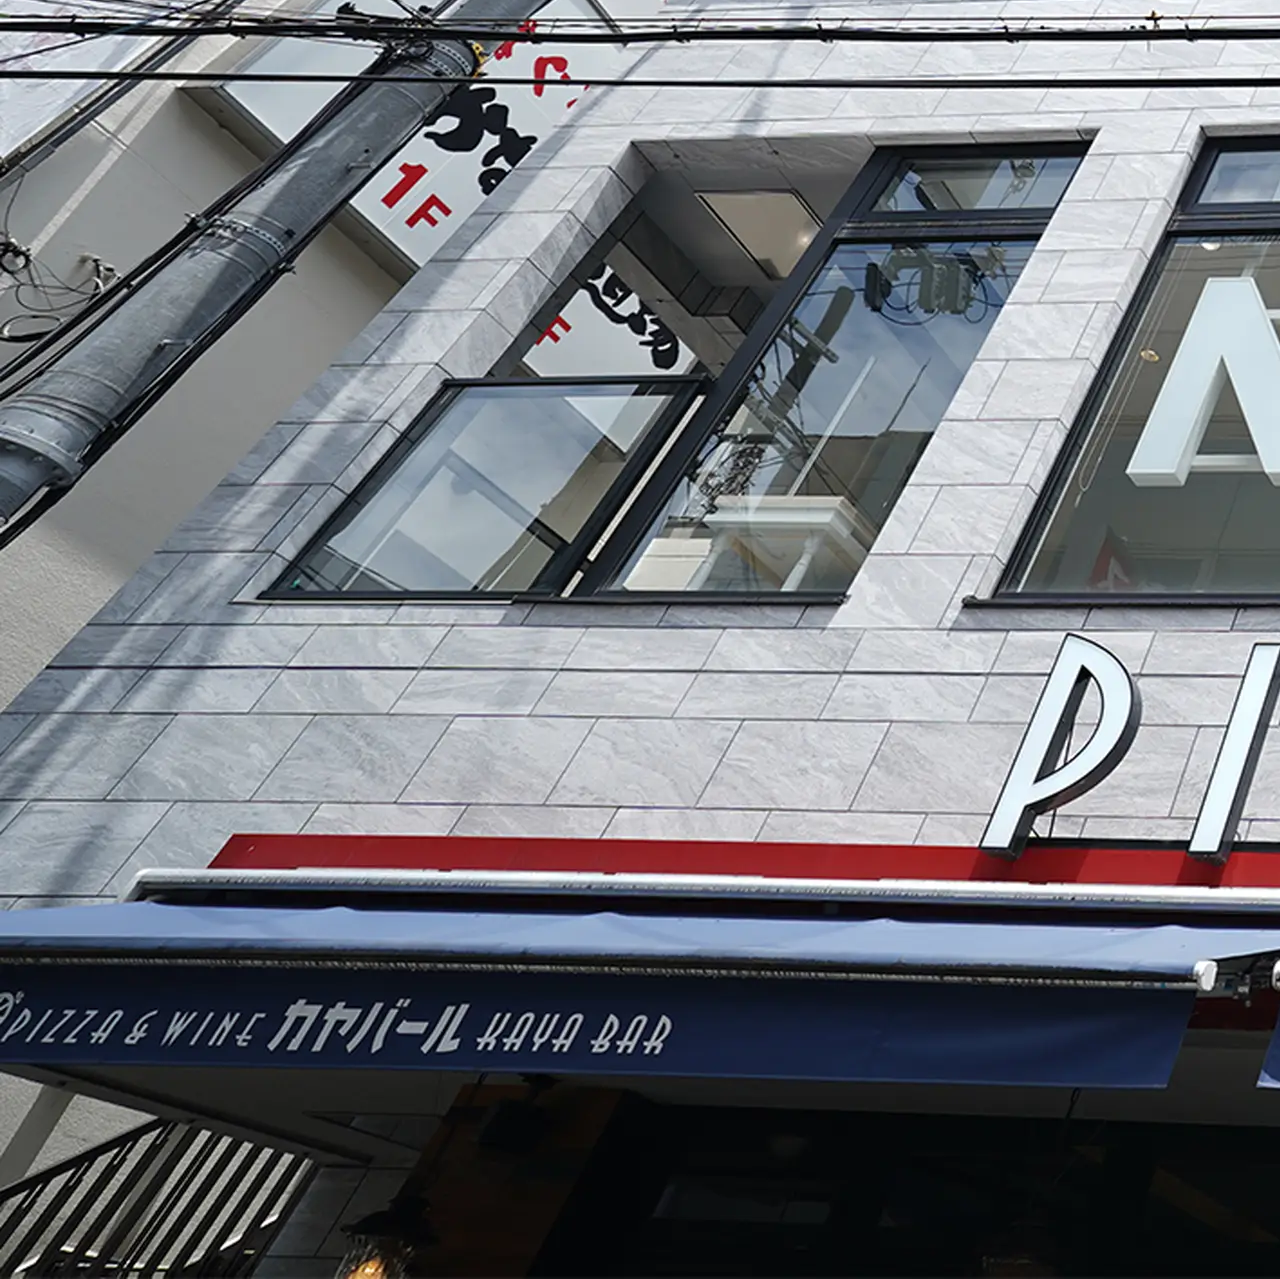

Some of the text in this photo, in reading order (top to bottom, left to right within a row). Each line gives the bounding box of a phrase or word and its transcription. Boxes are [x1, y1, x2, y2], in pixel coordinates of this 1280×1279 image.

[381, 153, 452, 228] 1F
[1, 998, 672, 1055] PIZZA & WINE カヤバール KAYA BAR
